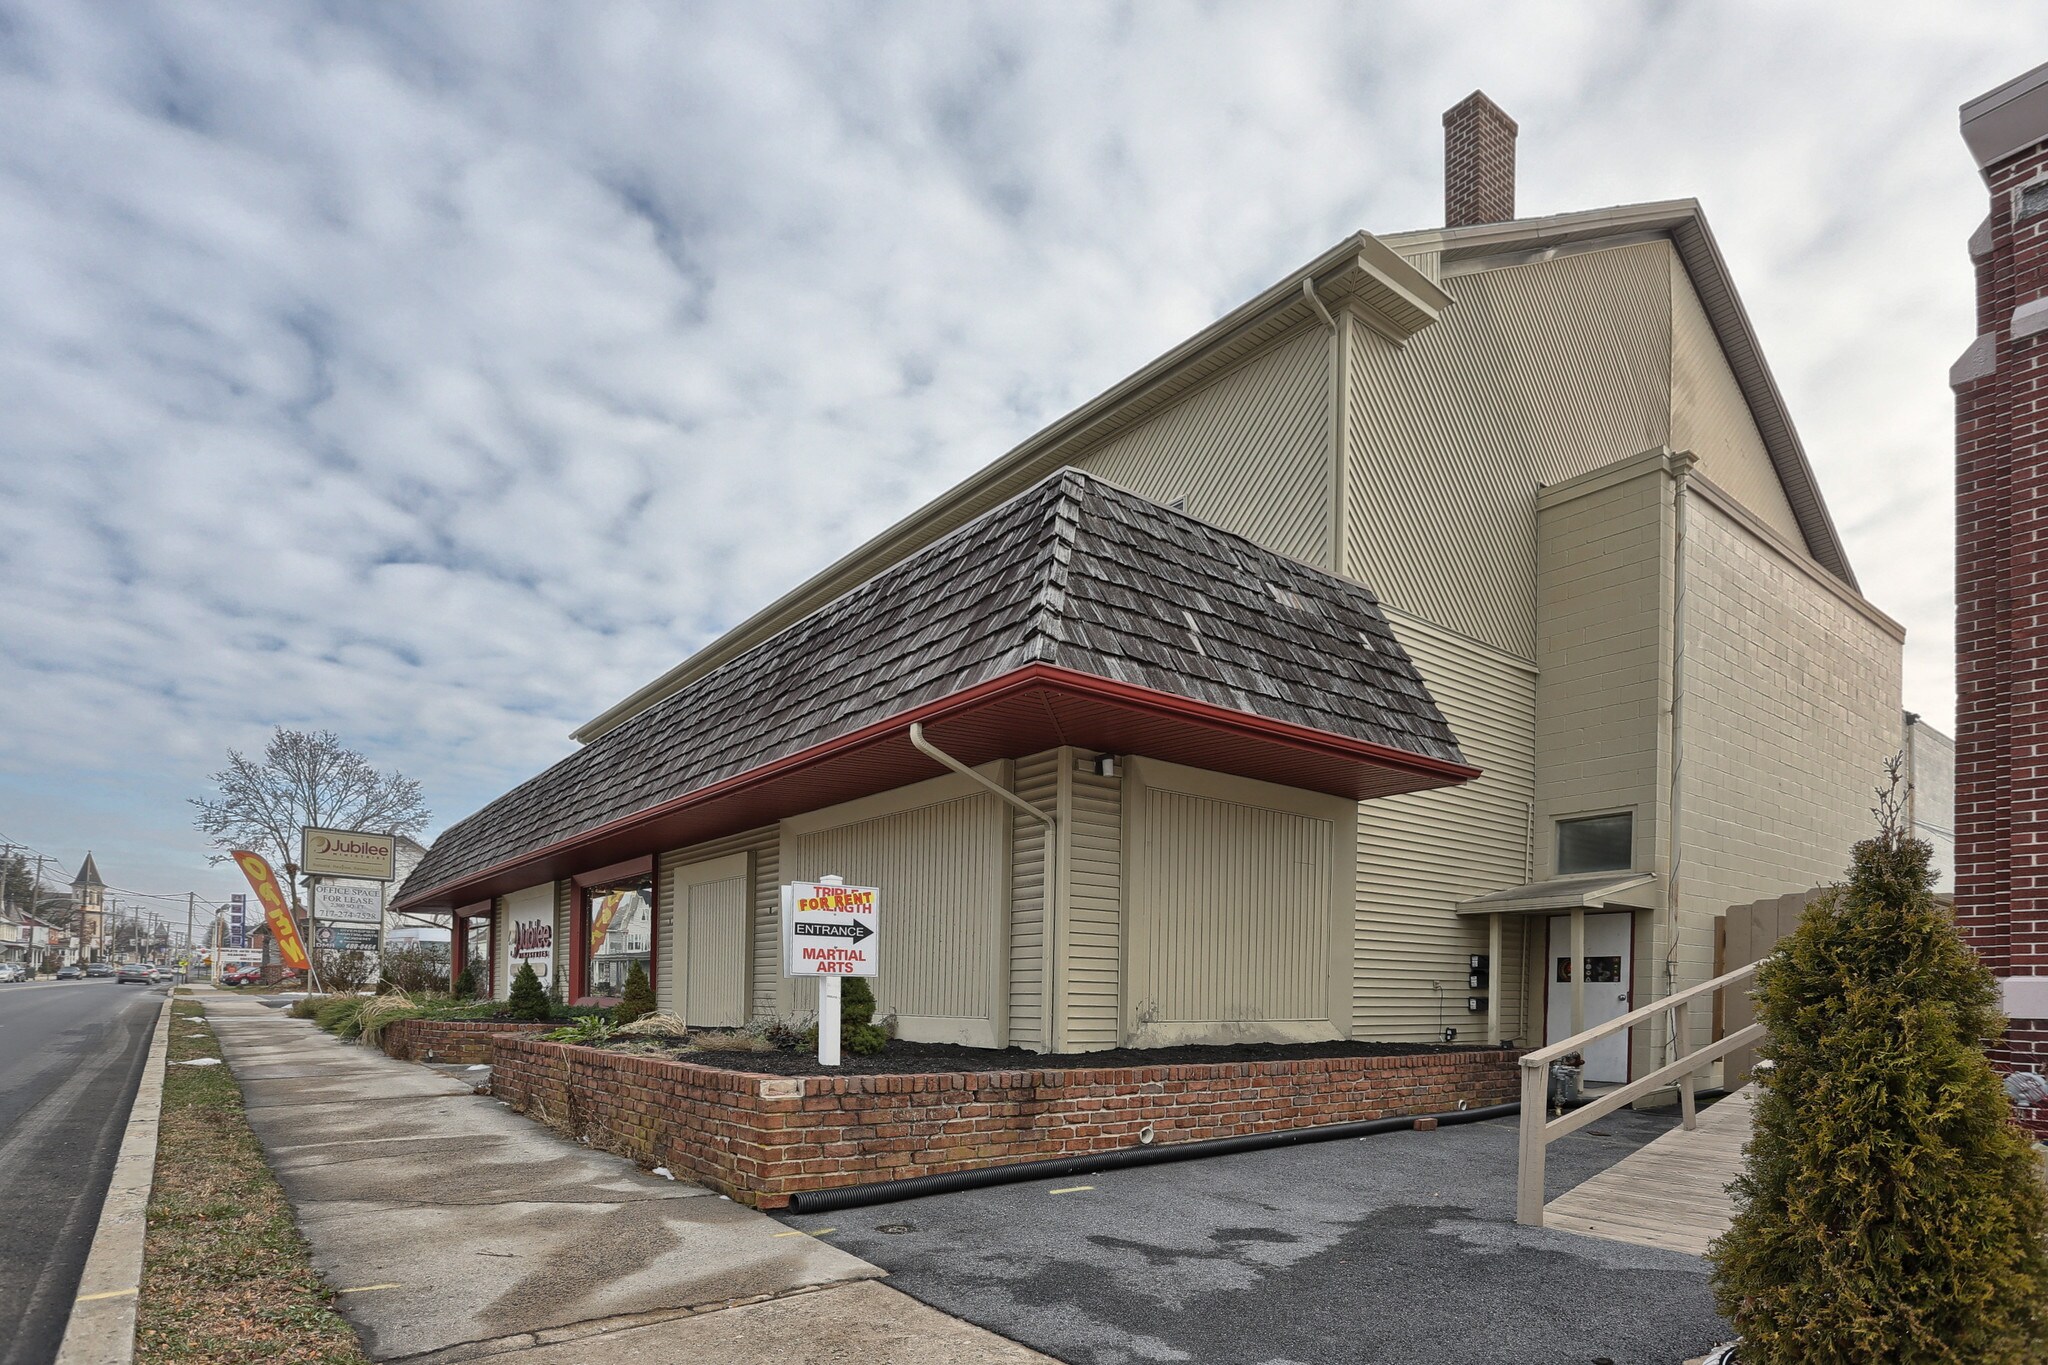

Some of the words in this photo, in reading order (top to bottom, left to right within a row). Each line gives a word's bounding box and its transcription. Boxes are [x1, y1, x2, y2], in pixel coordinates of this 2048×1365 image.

[331, 839, 389, 857] Jubilee
[316, 885, 350, 895] OFFICE
[352, 889, 380, 897] SPACE
[813, 886, 859, 898] TRIP
[323, 895, 342, 903] FOR
[344, 897, 374, 905] LEASE
[800, 896, 829, 911] FOR
[834, 892, 872, 908] RENT
[242, 857, 304, 963] OPEN
[320, 910, 377, 919] 717-274-7528
[796, 924, 864, 937] ENTRANCE
[511, 919, 552, 958] Jubilee
[802, 948, 866, 961] MARTIAL
[816, 961, 854, 973] ARTS
